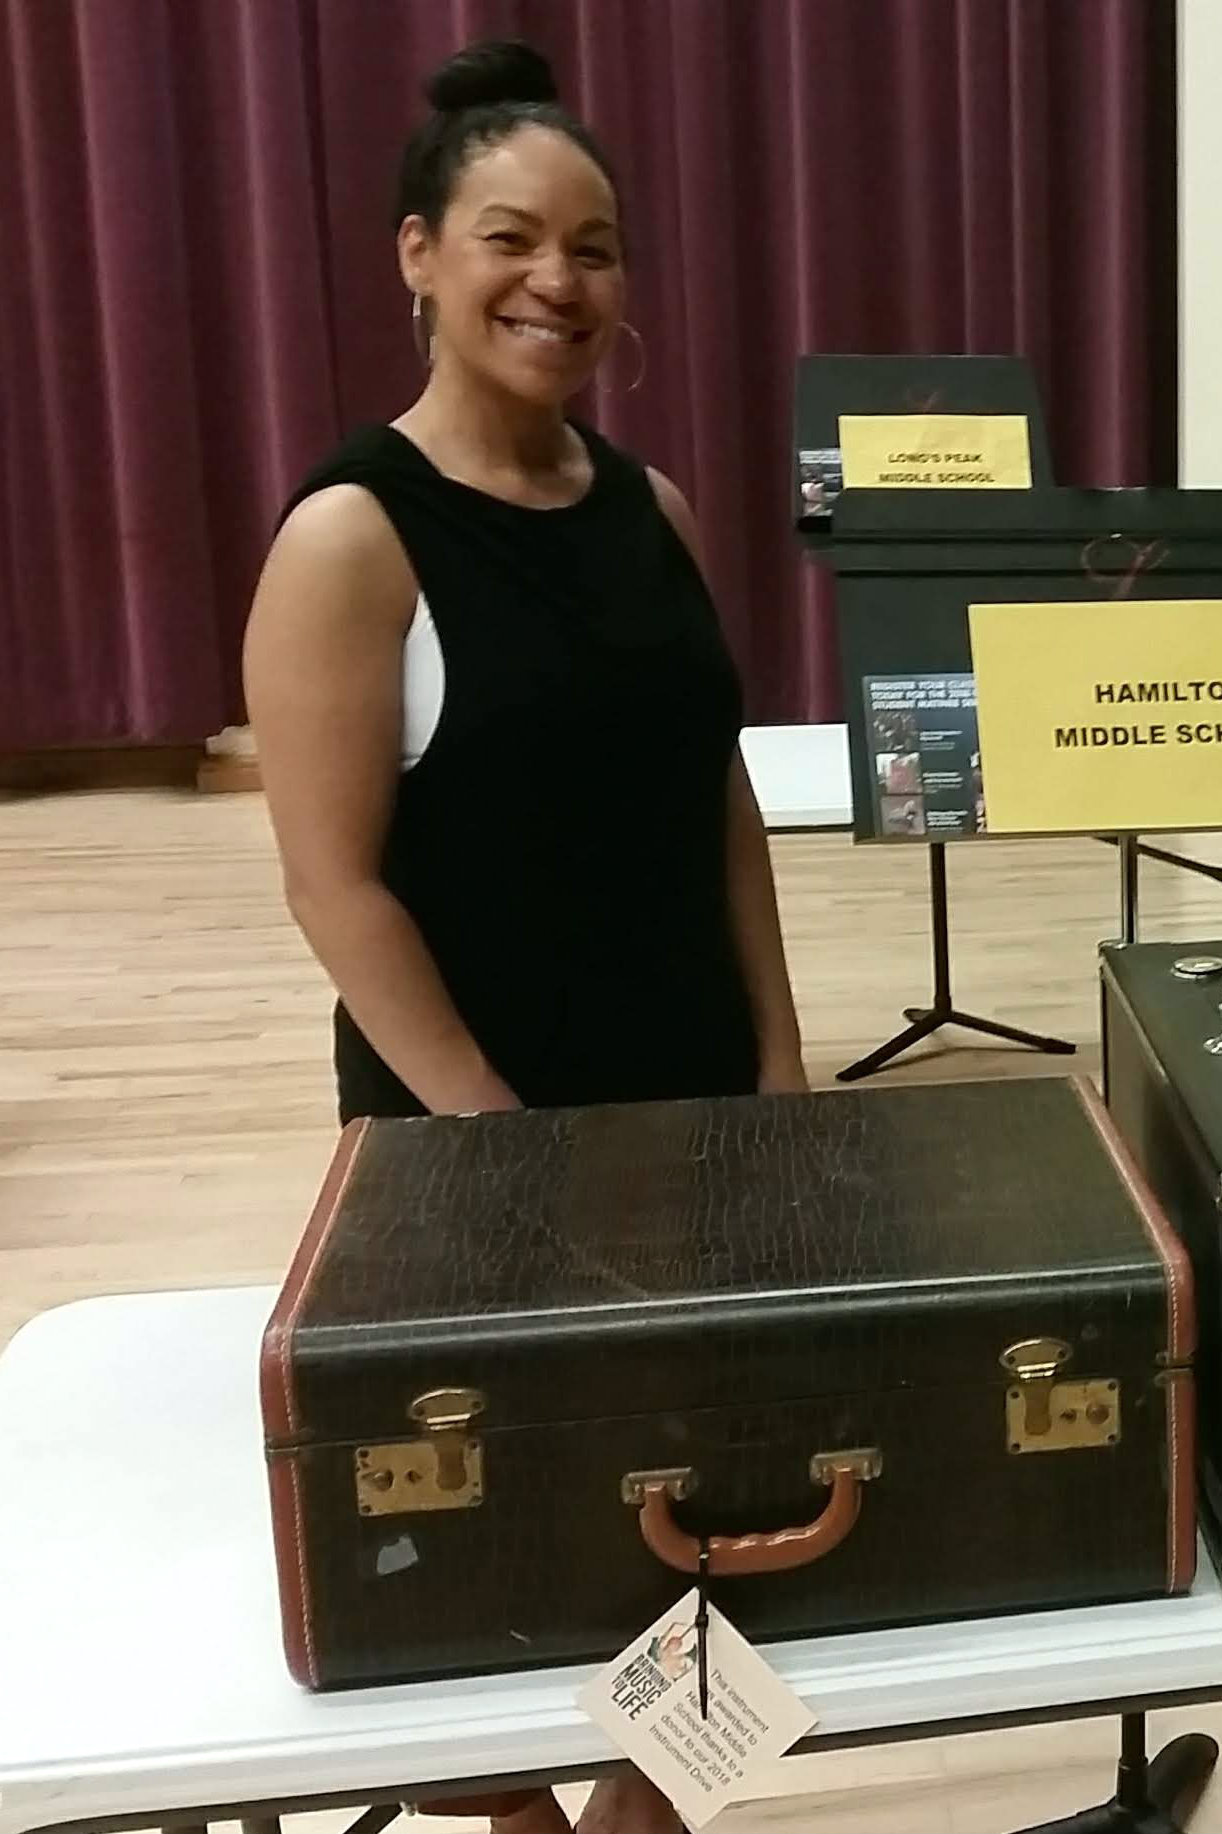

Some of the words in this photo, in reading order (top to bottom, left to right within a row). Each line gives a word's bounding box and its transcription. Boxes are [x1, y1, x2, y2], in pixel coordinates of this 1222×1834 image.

[879, 473, 932, 482] MIDDLE
[938, 472, 995, 483] SCHOOL
[944, 453, 983, 463] PEAK
[1054, 725, 1167, 748] MIDDLE
[611, 1675, 625, 1689] TO
[619, 1663, 662, 1704] MUSIC
[710, 1668, 728, 1690] This
[727, 1688, 769, 1733] instrument
[611, 1684, 649, 1721] LIFE
[673, 1702, 703, 1733] School
[701, 1731, 727, 1762] thanks
[726, 1759, 737, 1771] to
[735, 1770, 744, 1778] a
[713, 1699, 751, 1736] awarded
[747, 1734, 757, 1746] to
[649, 1723, 693, 1770] Instrument
[689, 1767, 713, 1792] Drive
[660, 1714, 686, 1739] donor
[684, 1737, 695, 1750] to
[693, 1748, 709, 1764] our
[707, 1762, 731, 1786] 2018
[720, 1727, 747, 1758] Middle
